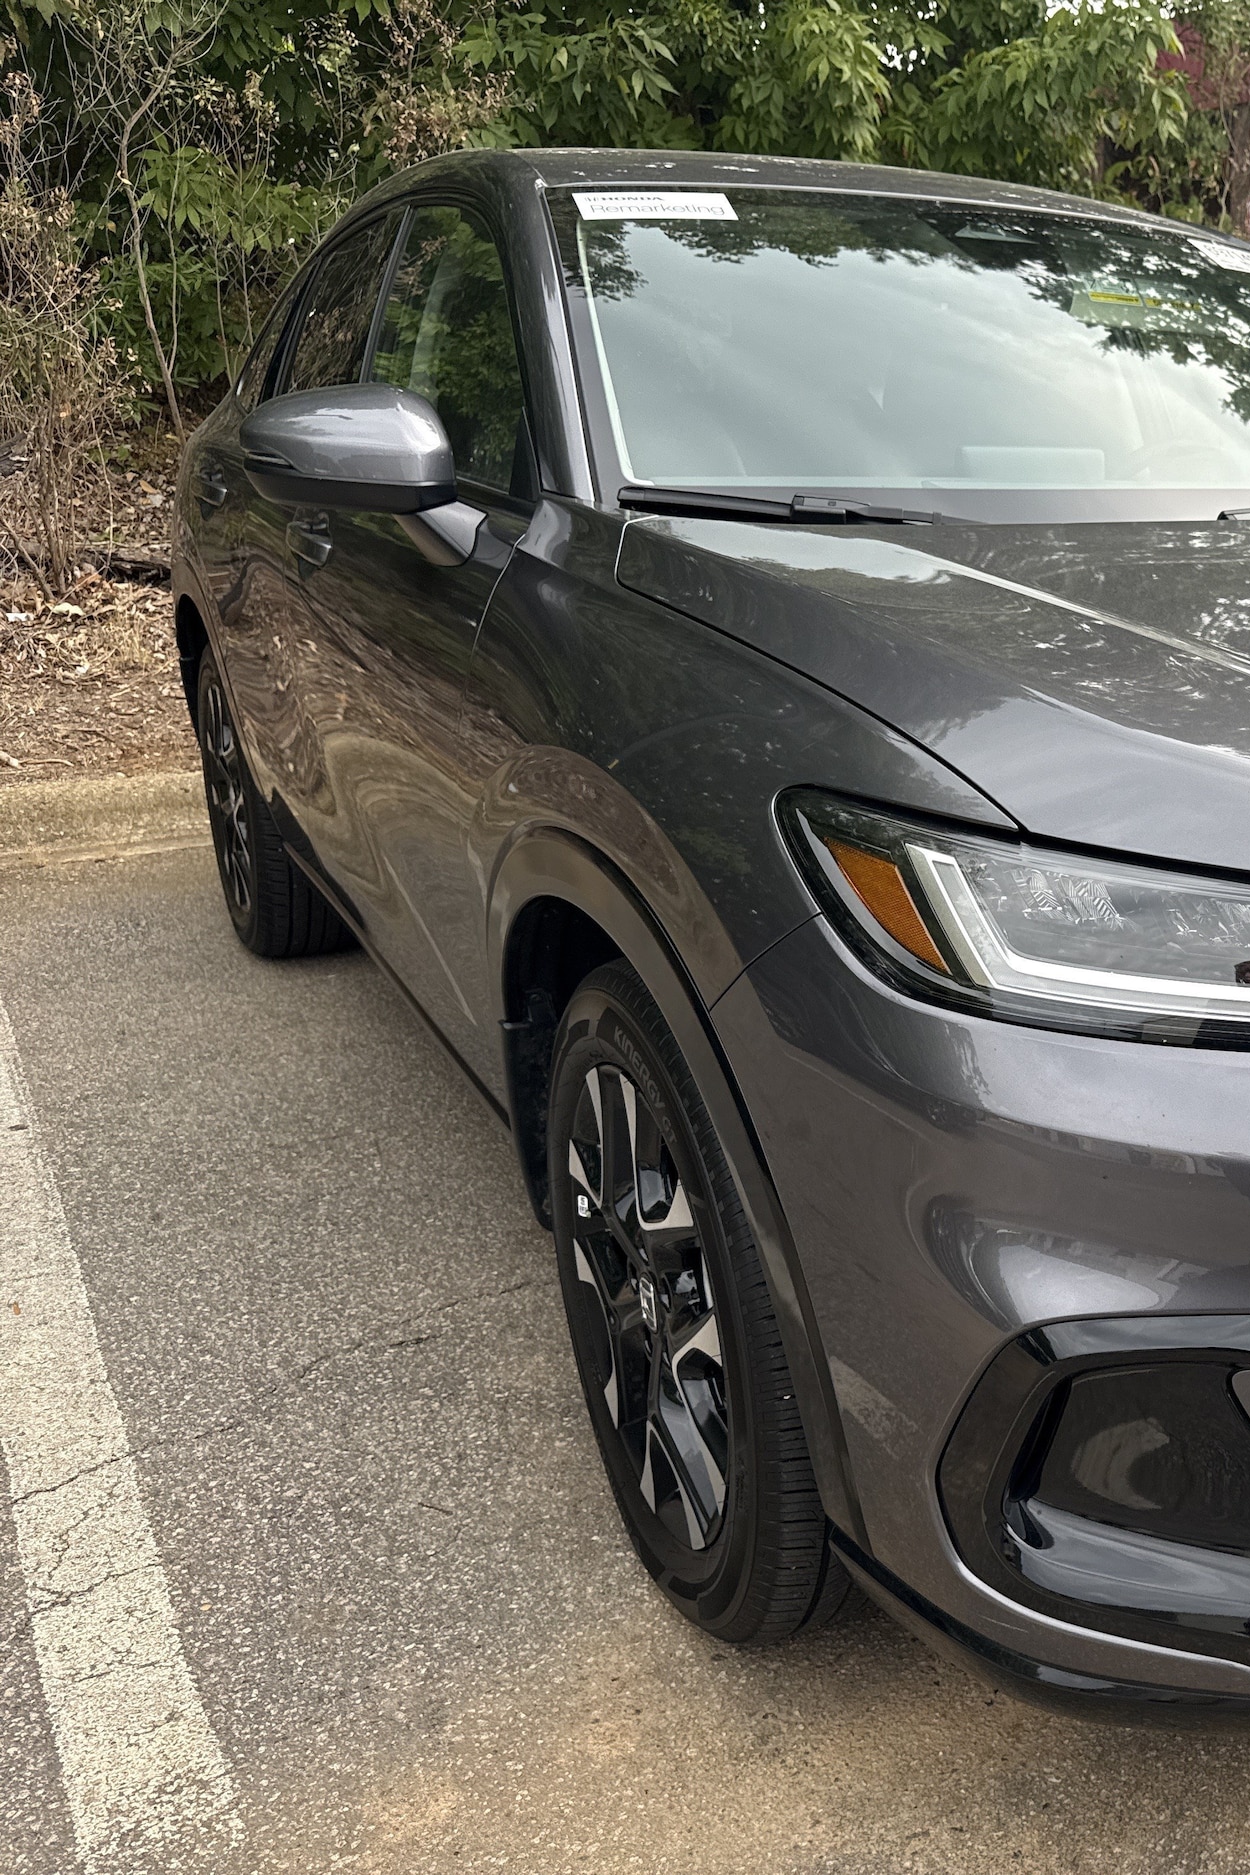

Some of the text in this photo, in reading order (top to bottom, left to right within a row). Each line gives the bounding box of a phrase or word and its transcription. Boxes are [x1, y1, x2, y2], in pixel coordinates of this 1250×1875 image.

[590, 203, 726, 216] Remarketing
[614, 1025, 677, 1143] KINERGY GT
